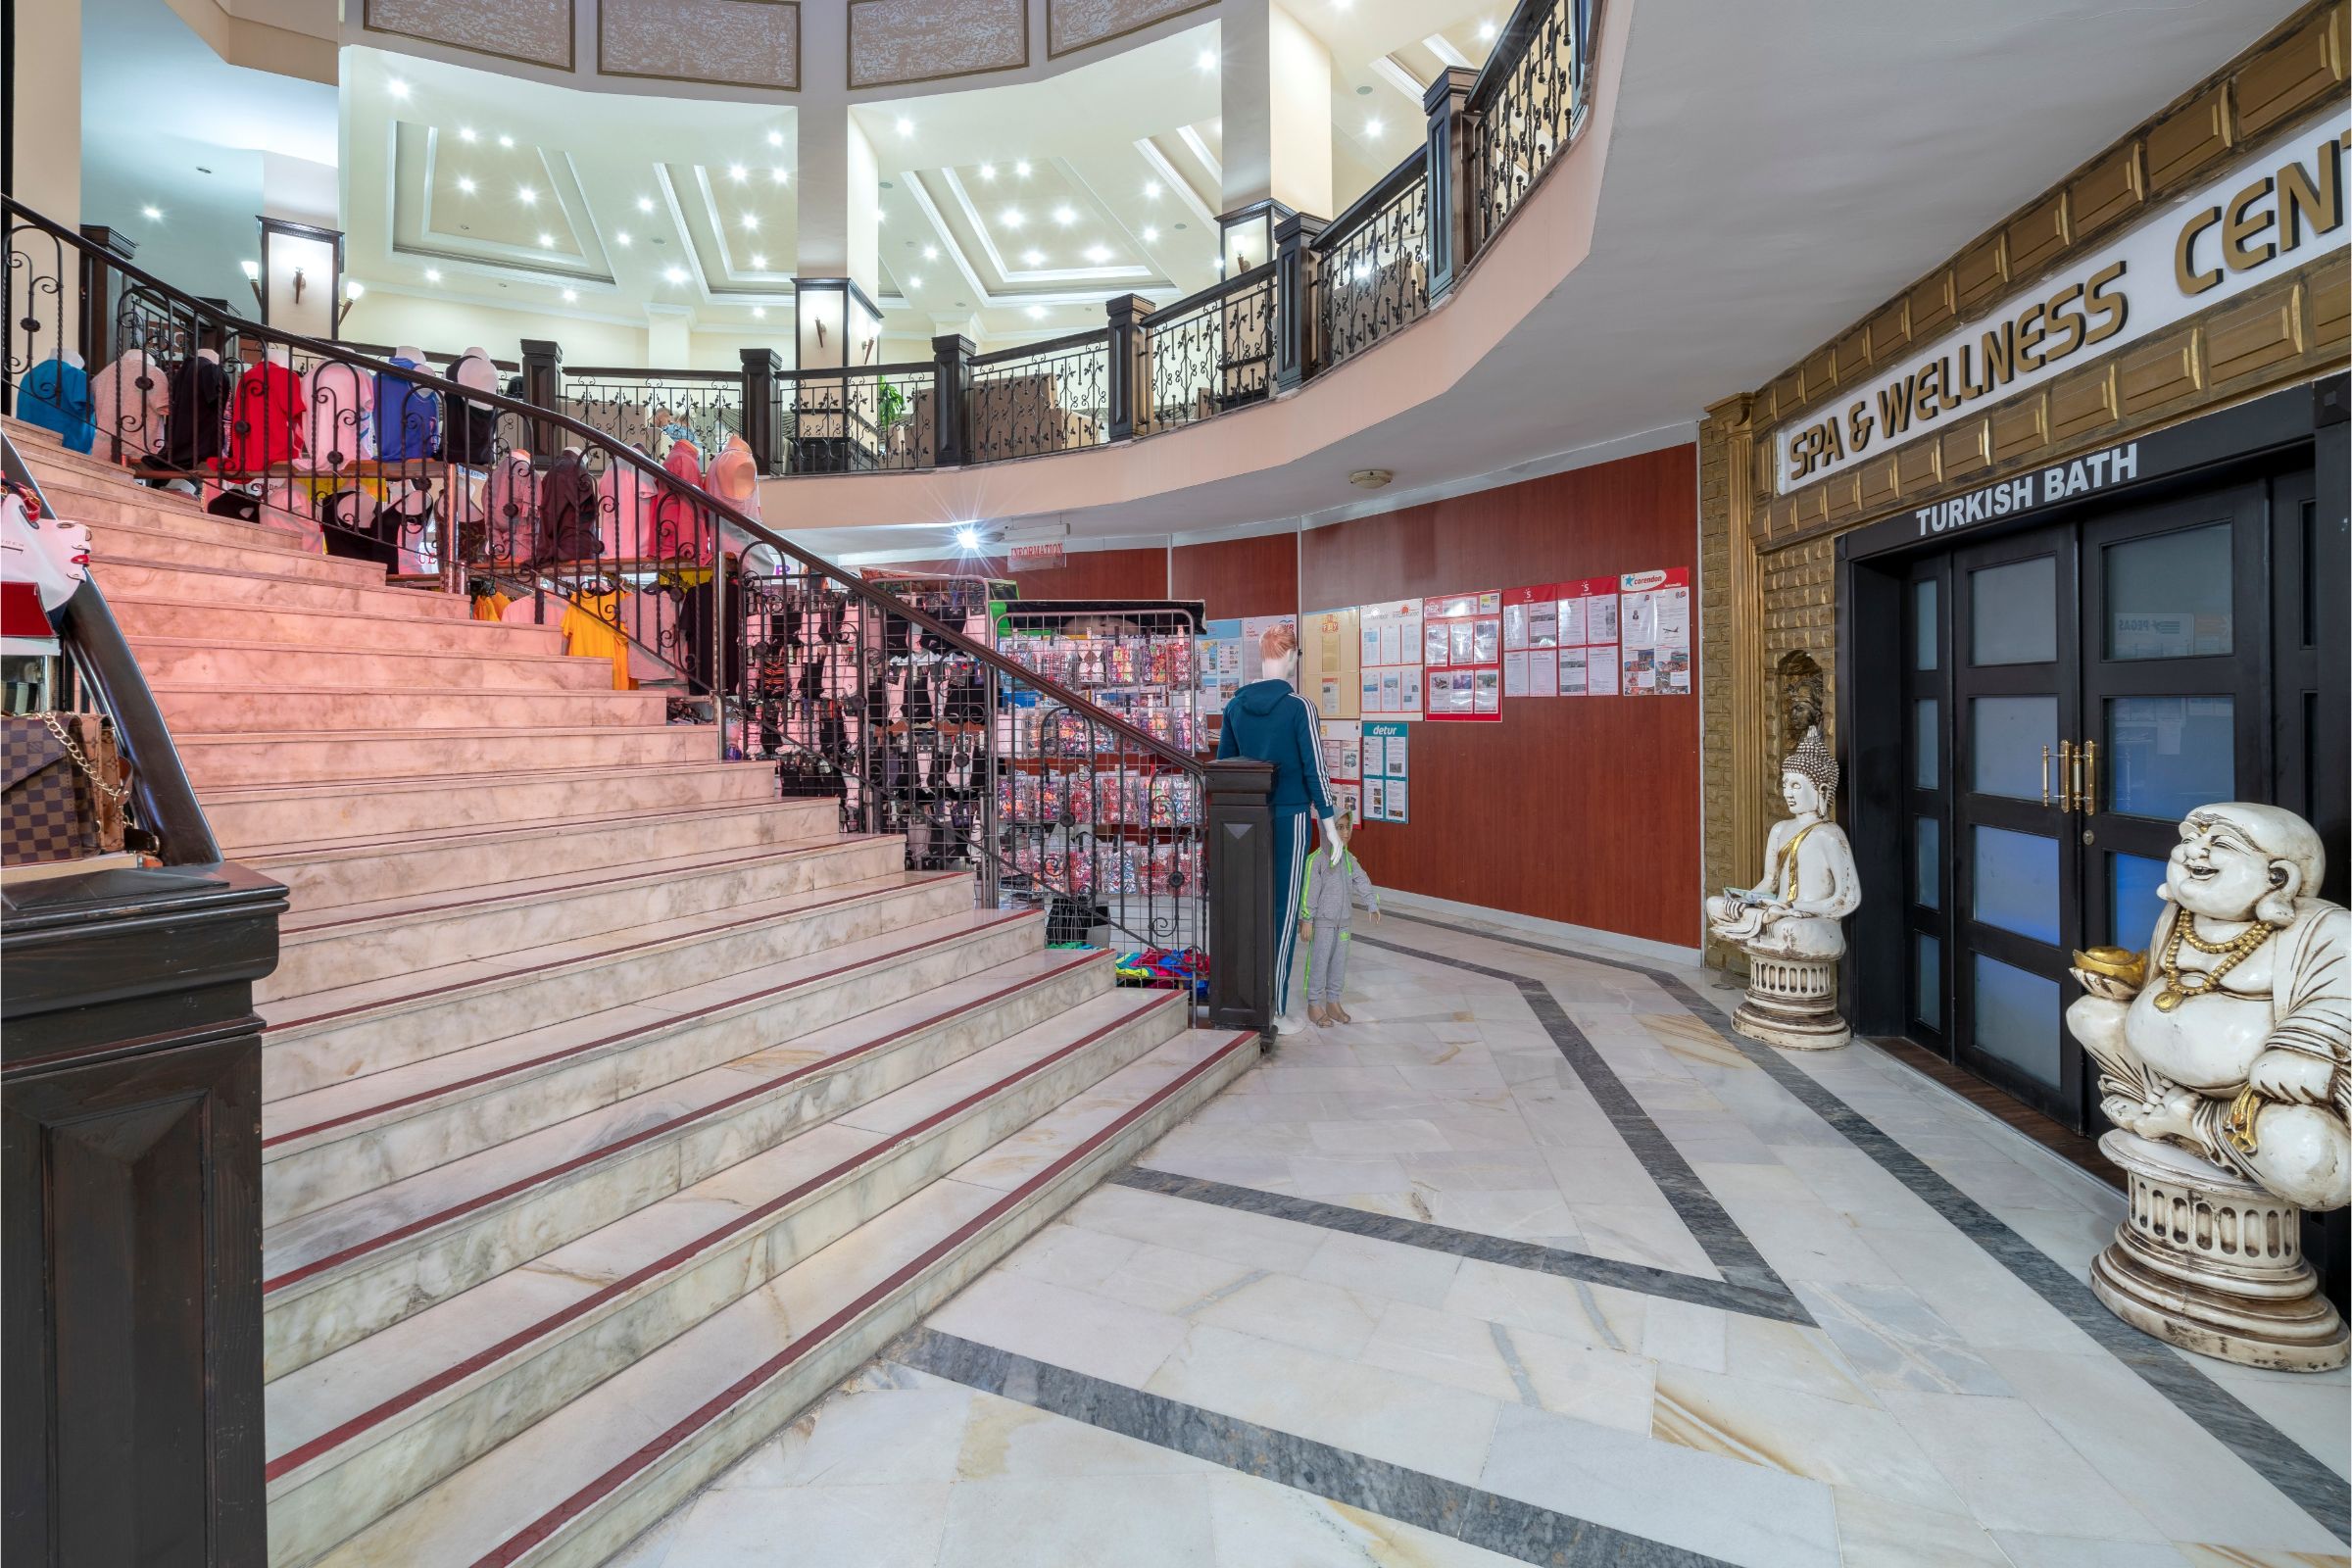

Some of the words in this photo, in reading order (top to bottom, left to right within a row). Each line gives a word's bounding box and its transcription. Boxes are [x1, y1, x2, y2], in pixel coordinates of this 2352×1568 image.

[1788, 415, 1843, 481] SPA
[1847, 400, 1875, 454] &
[1876, 260, 2130, 439] WELLNESS
[1916, 475, 2034, 537] TURKISH
[2044, 443, 2138, 503] BATH
[1010, 542, 1063, 561] INFORMATION
[1634, 574, 1662, 586] corendon
[1373, 724, 1397, 735] detur
